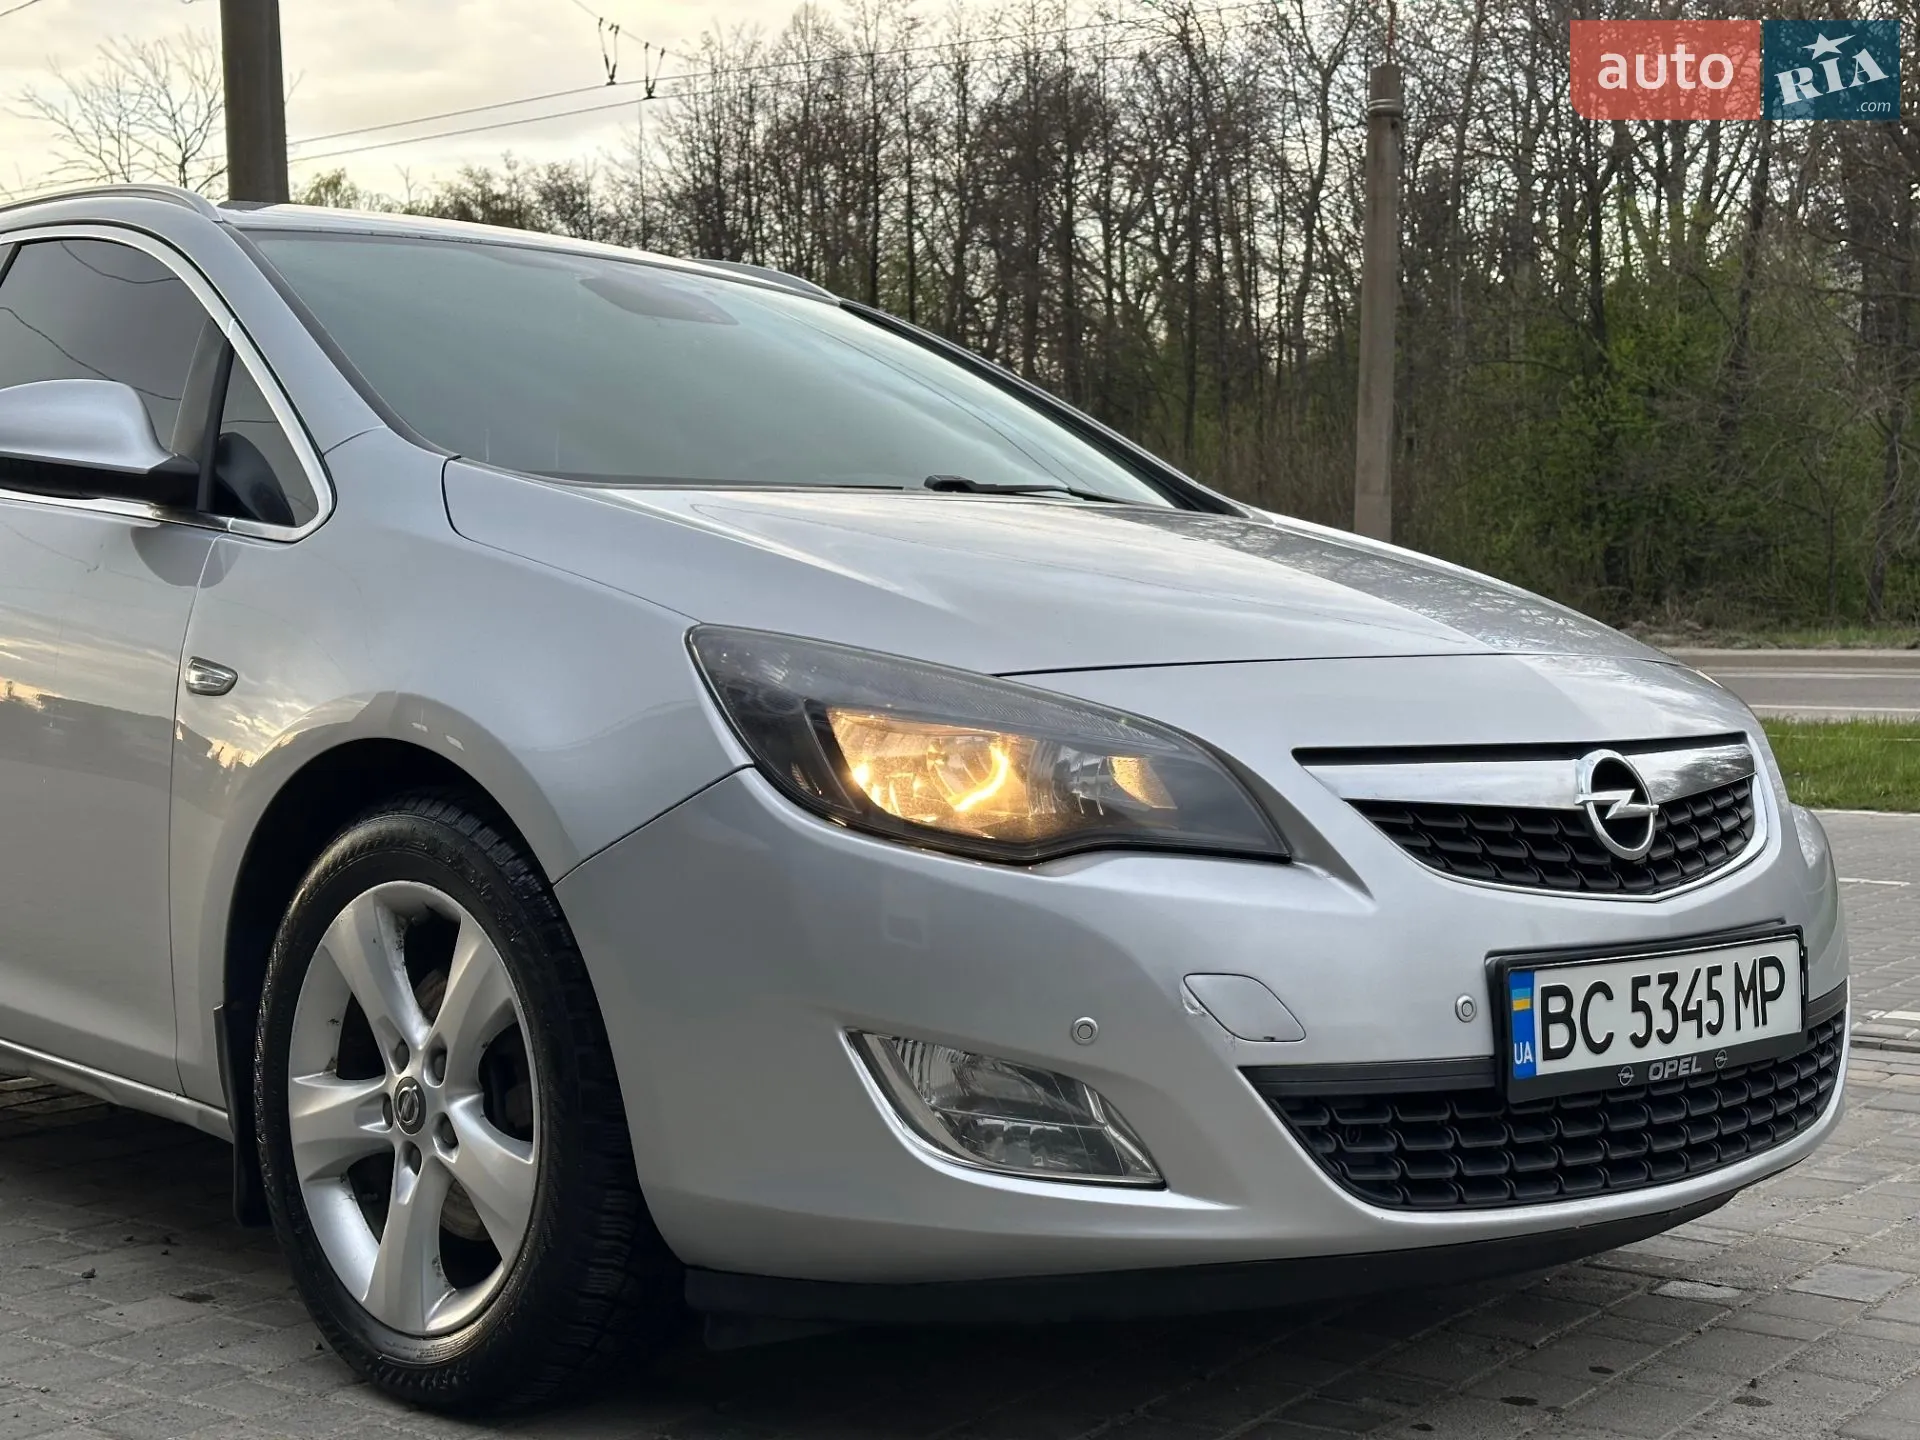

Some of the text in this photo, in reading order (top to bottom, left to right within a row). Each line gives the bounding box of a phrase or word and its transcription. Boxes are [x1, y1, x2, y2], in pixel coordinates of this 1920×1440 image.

[1541, 956, 1786, 1061] BC 5345 MP
[1515, 1041, 1533, 1065] UA
[1648, 1056, 1702, 1081] OPEL
